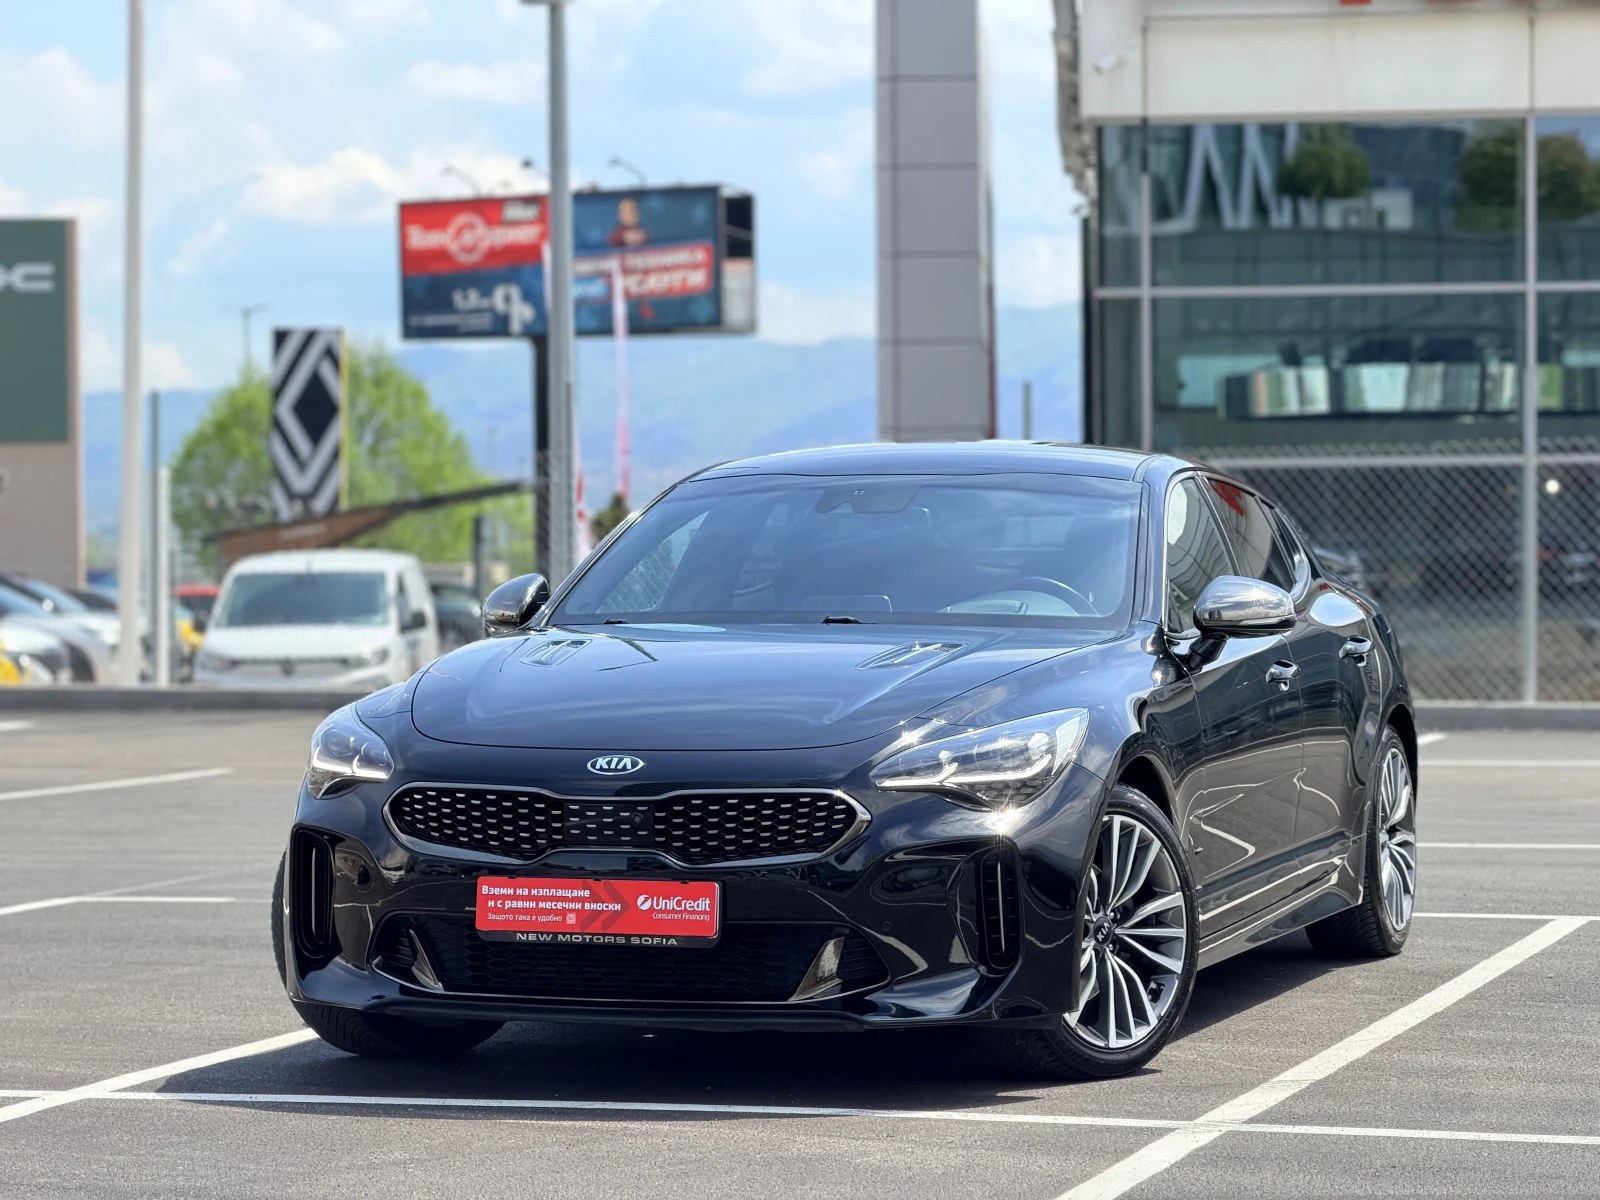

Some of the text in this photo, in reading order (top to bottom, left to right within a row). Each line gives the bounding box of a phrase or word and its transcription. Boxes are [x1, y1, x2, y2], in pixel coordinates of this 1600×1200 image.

[595, 757, 632, 770] KIA
[481, 885, 591, 898] Вземи на изплащане
[488, 900, 622, 911] и с равни месечни вноски
[653, 896, 711, 912] UniCredit
[487, 912, 514, 921] Защото
[537, 914, 563, 923] удобно
[652, 912, 710, 922] Consumer Financing
[1096, 922, 1111, 942] KIA
[516, 933, 678, 946] NEW MOTORS SOFIA
